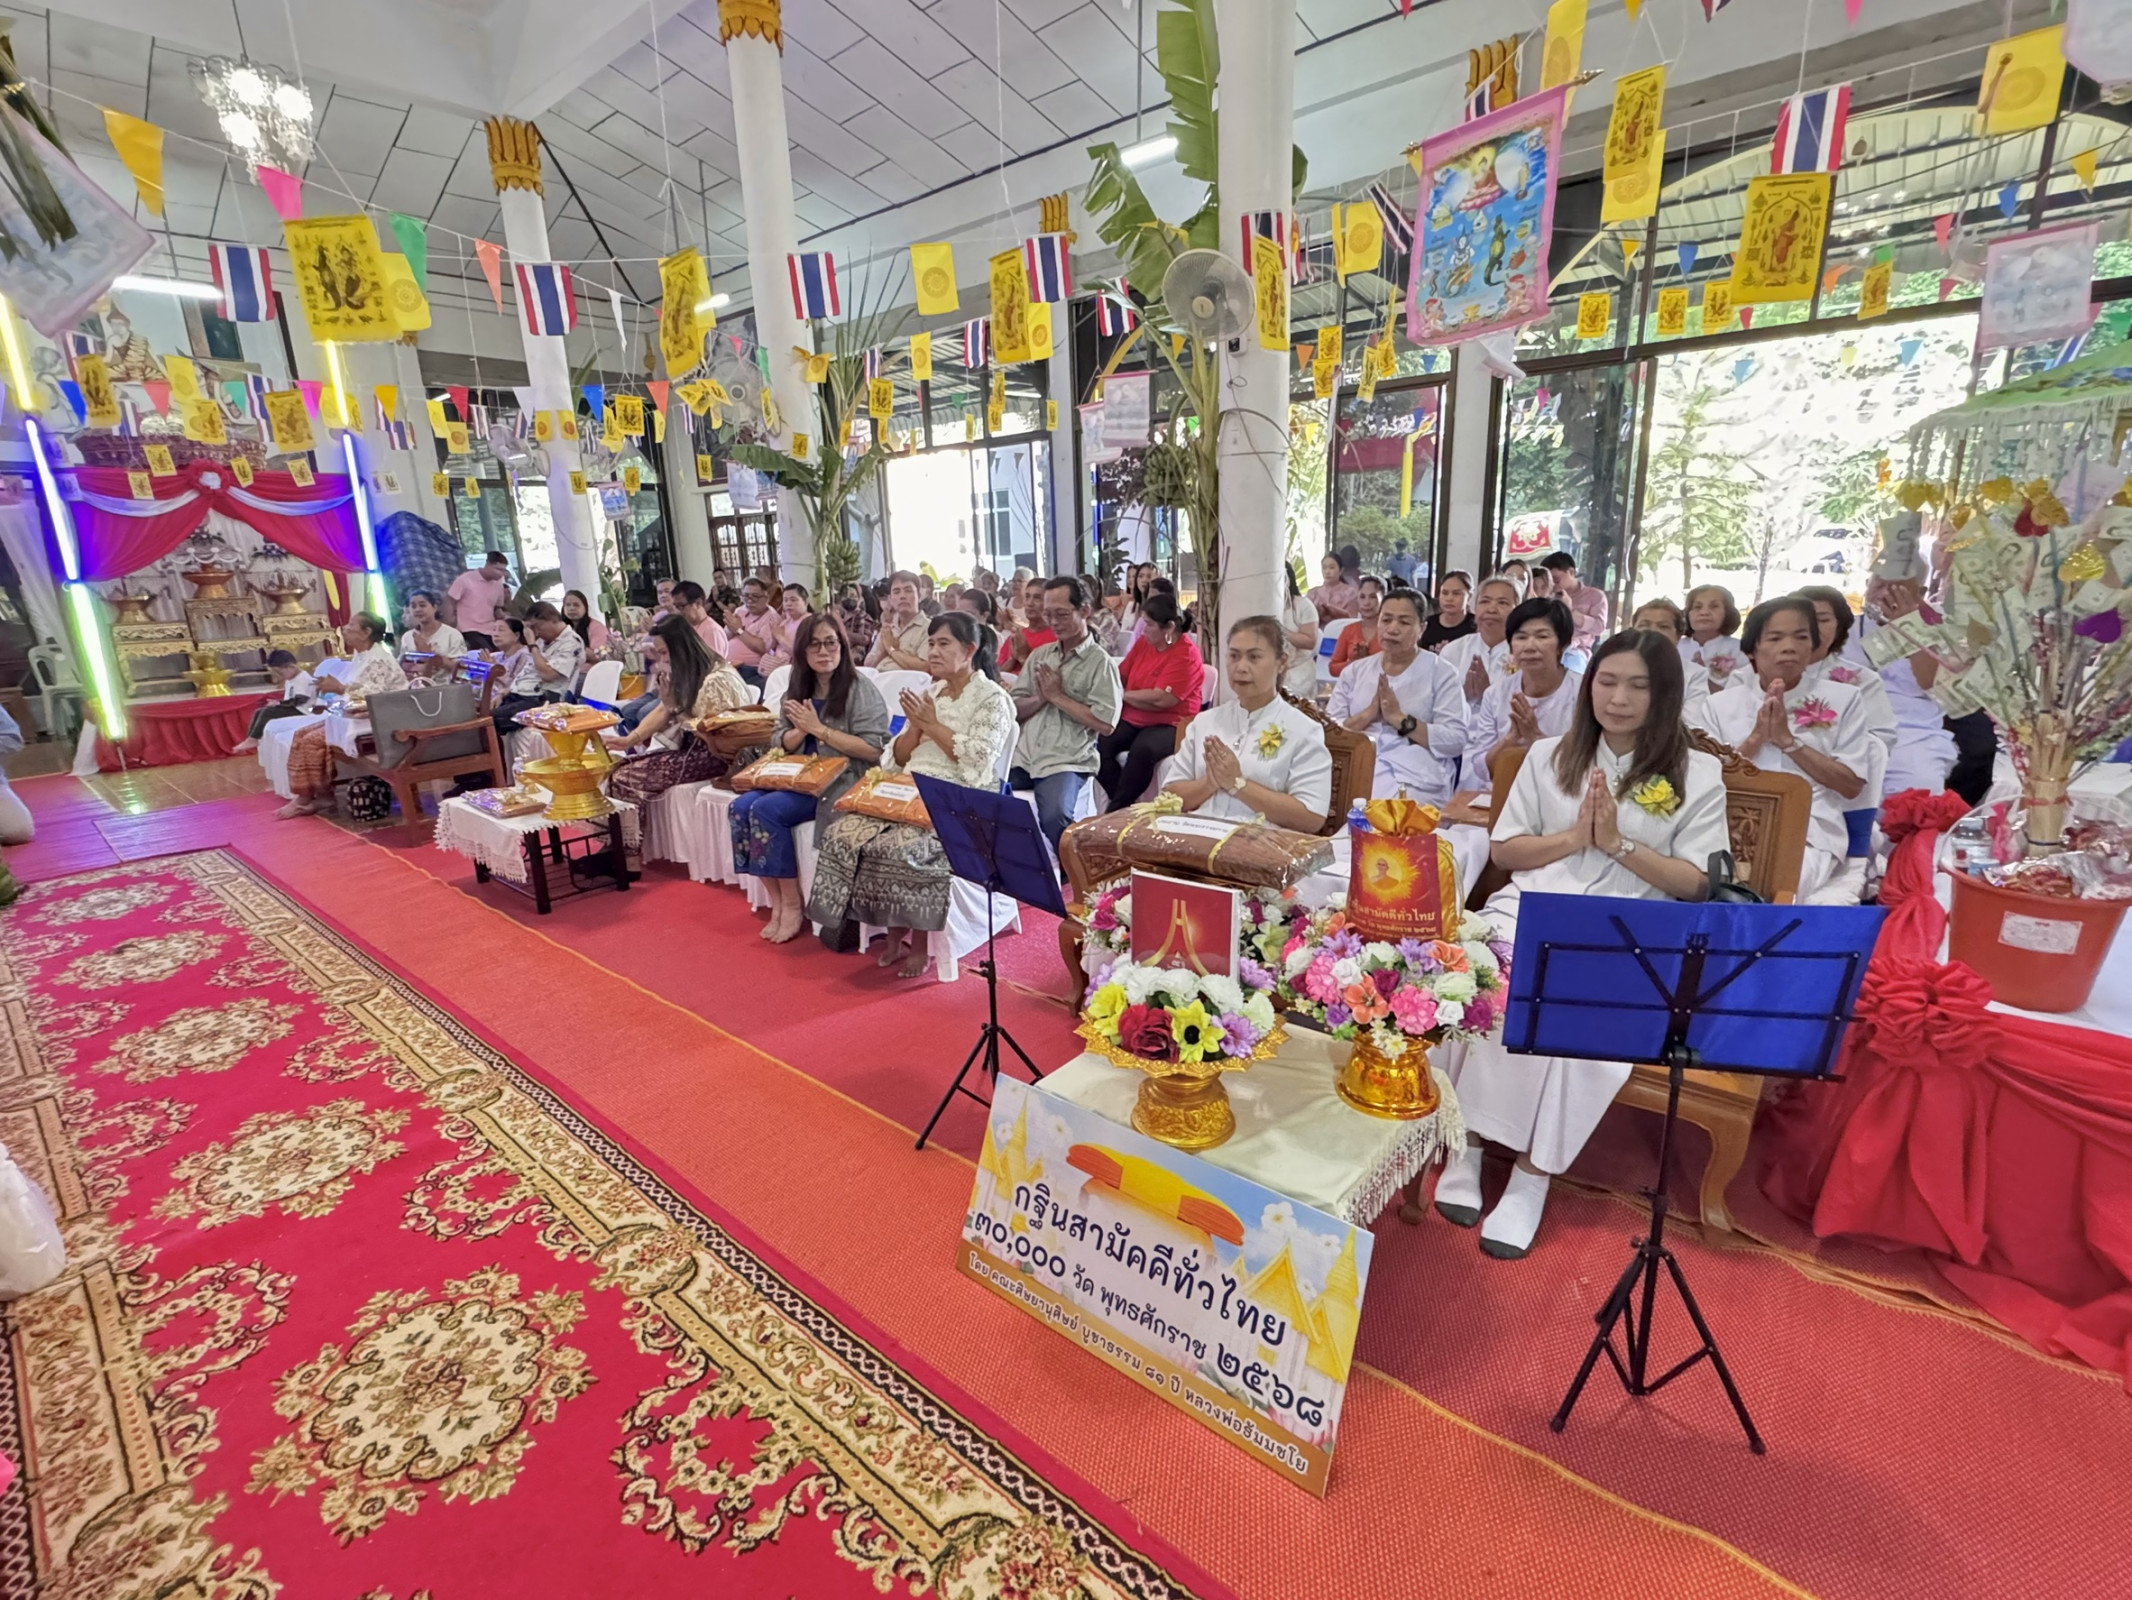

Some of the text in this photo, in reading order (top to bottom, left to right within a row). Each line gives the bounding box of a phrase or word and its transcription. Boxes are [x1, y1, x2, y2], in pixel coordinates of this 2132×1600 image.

[970, 1252, 1308, 1472] โดย คณะศิษยานุศิษย์ บูชาธรรม ๘๑ ปี หลวงพ่อธัมมชโย
[974, 1212, 1325, 1427] ๓๐,๐๐๐ วัด พุทธศักราช ๒๕๖๘
[1015, 1183, 1286, 1346] กฐินสามัคคีทั่วไทย
